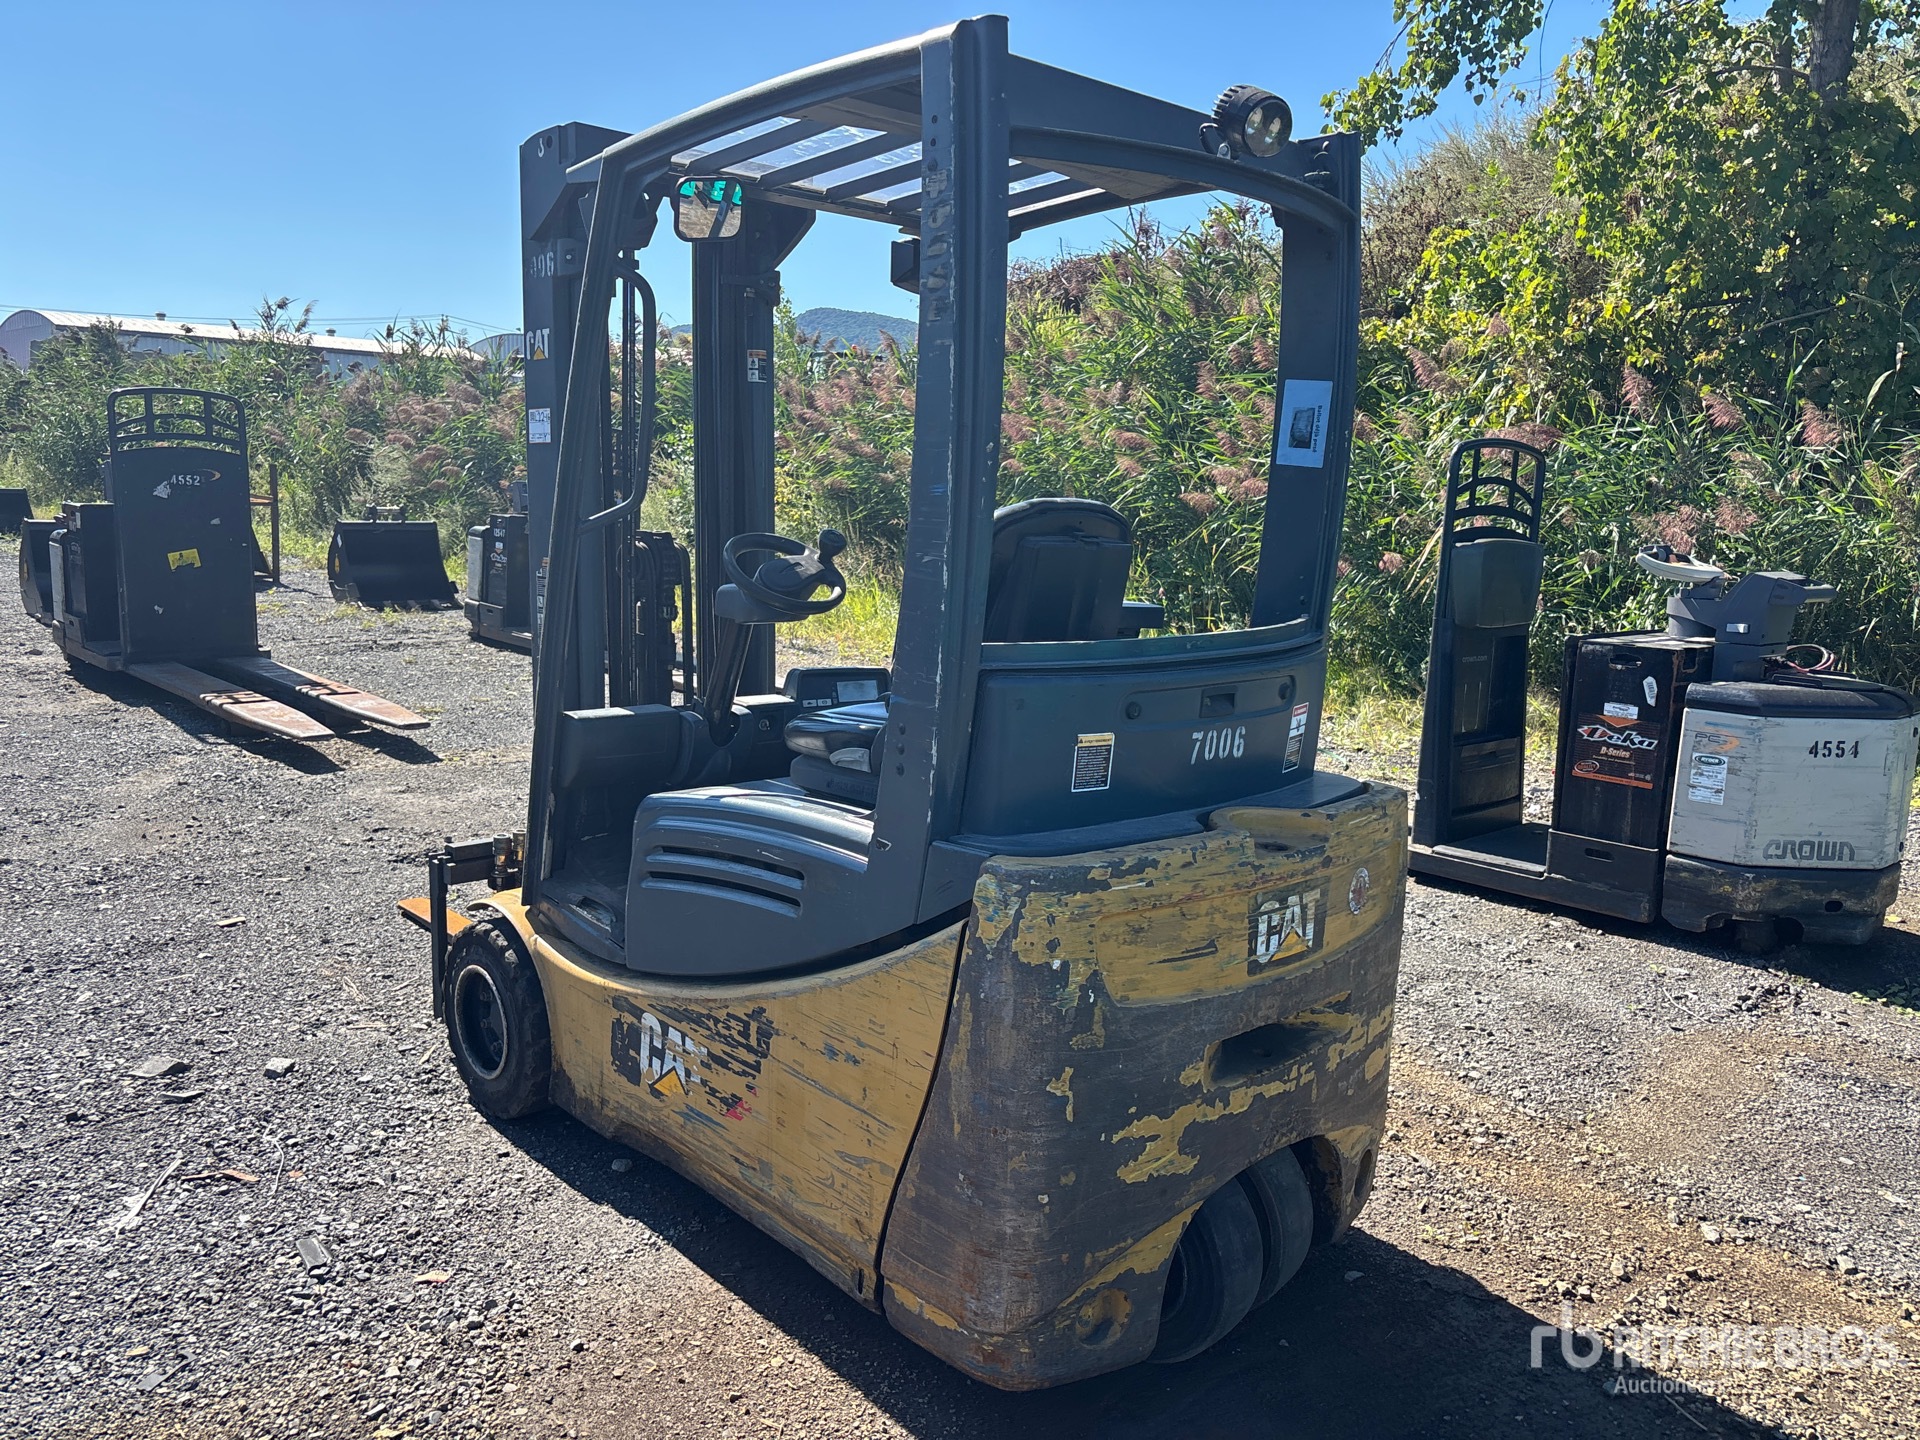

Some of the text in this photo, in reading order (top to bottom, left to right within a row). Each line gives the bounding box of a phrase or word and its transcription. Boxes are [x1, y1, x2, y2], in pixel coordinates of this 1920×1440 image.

[526, 328, 550, 360] CAT
[170, 474, 200, 486] 4552
[1190, 726, 1246, 765] 7006
[1577, 725, 1658, 750] Deka
[1808, 740, 1860, 758] 4554
[1762, 839, 1856, 861] CROWN
[1256, 888, 1321, 964] CAT
